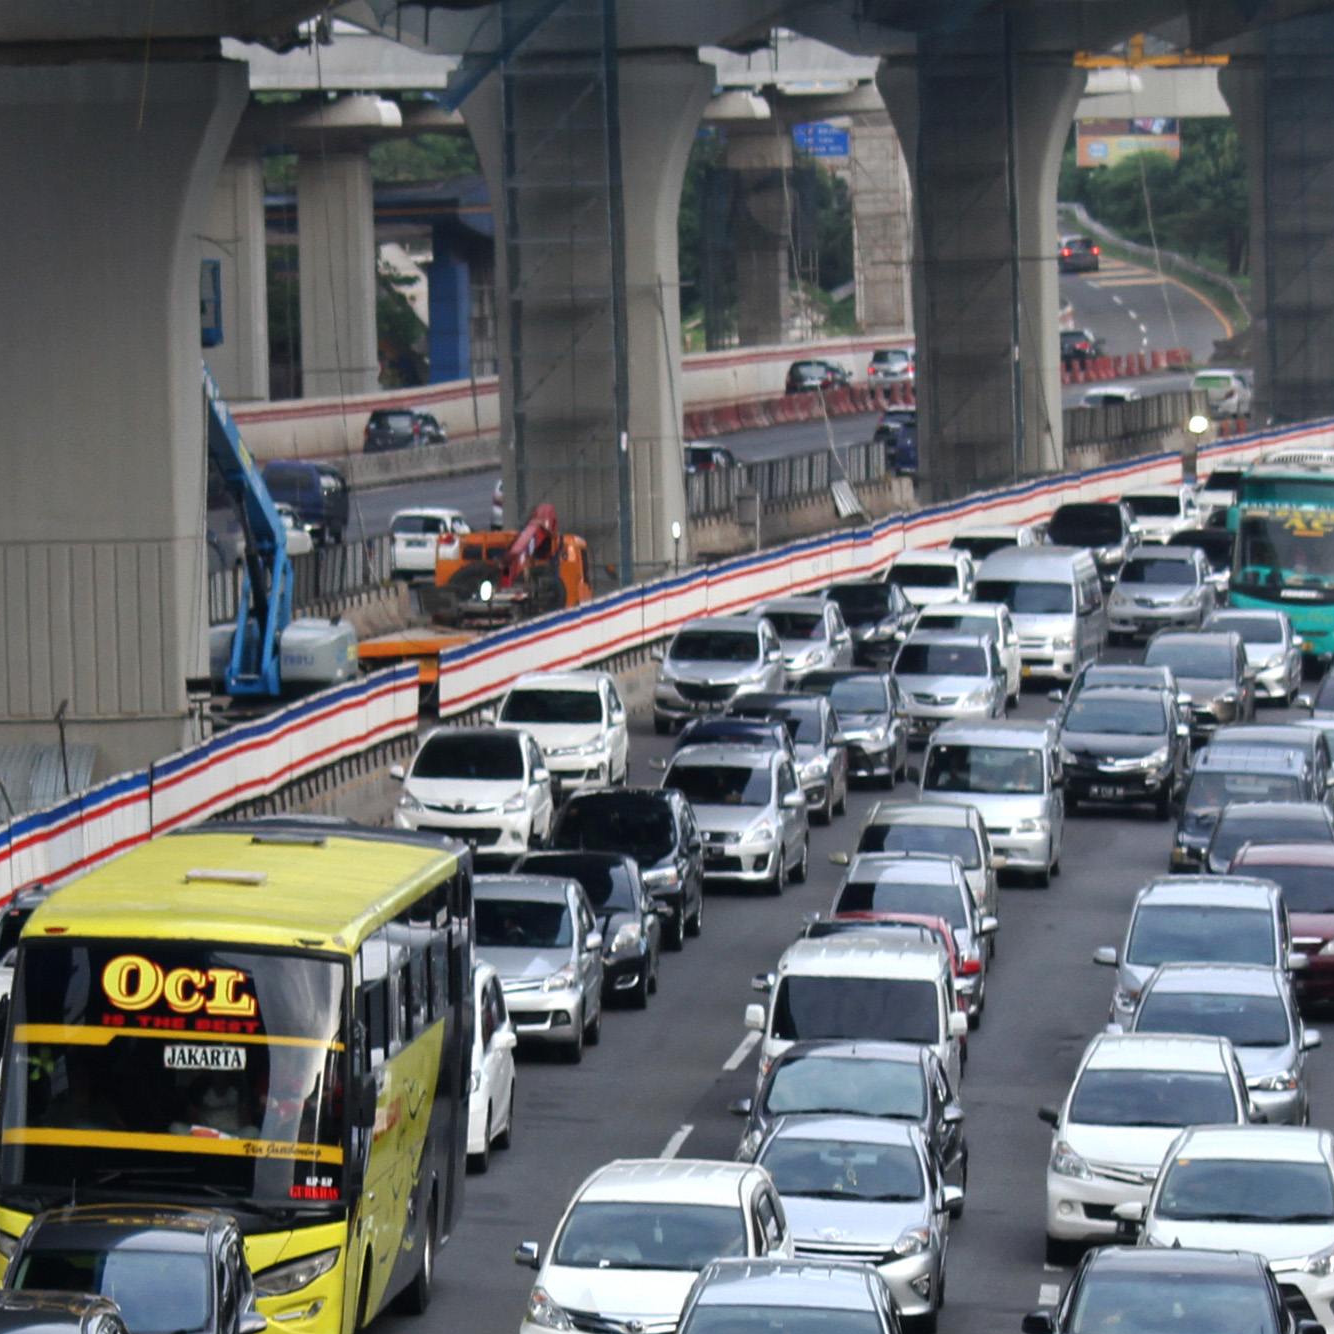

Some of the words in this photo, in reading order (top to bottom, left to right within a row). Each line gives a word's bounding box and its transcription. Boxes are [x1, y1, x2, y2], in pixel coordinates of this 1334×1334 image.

[101, 953, 257, 1017] OCL
[135, 1014, 186, 1030] THE
[194, 1017, 260, 1034] BEST
[167, 1047, 243, 1067] JAKARTA
